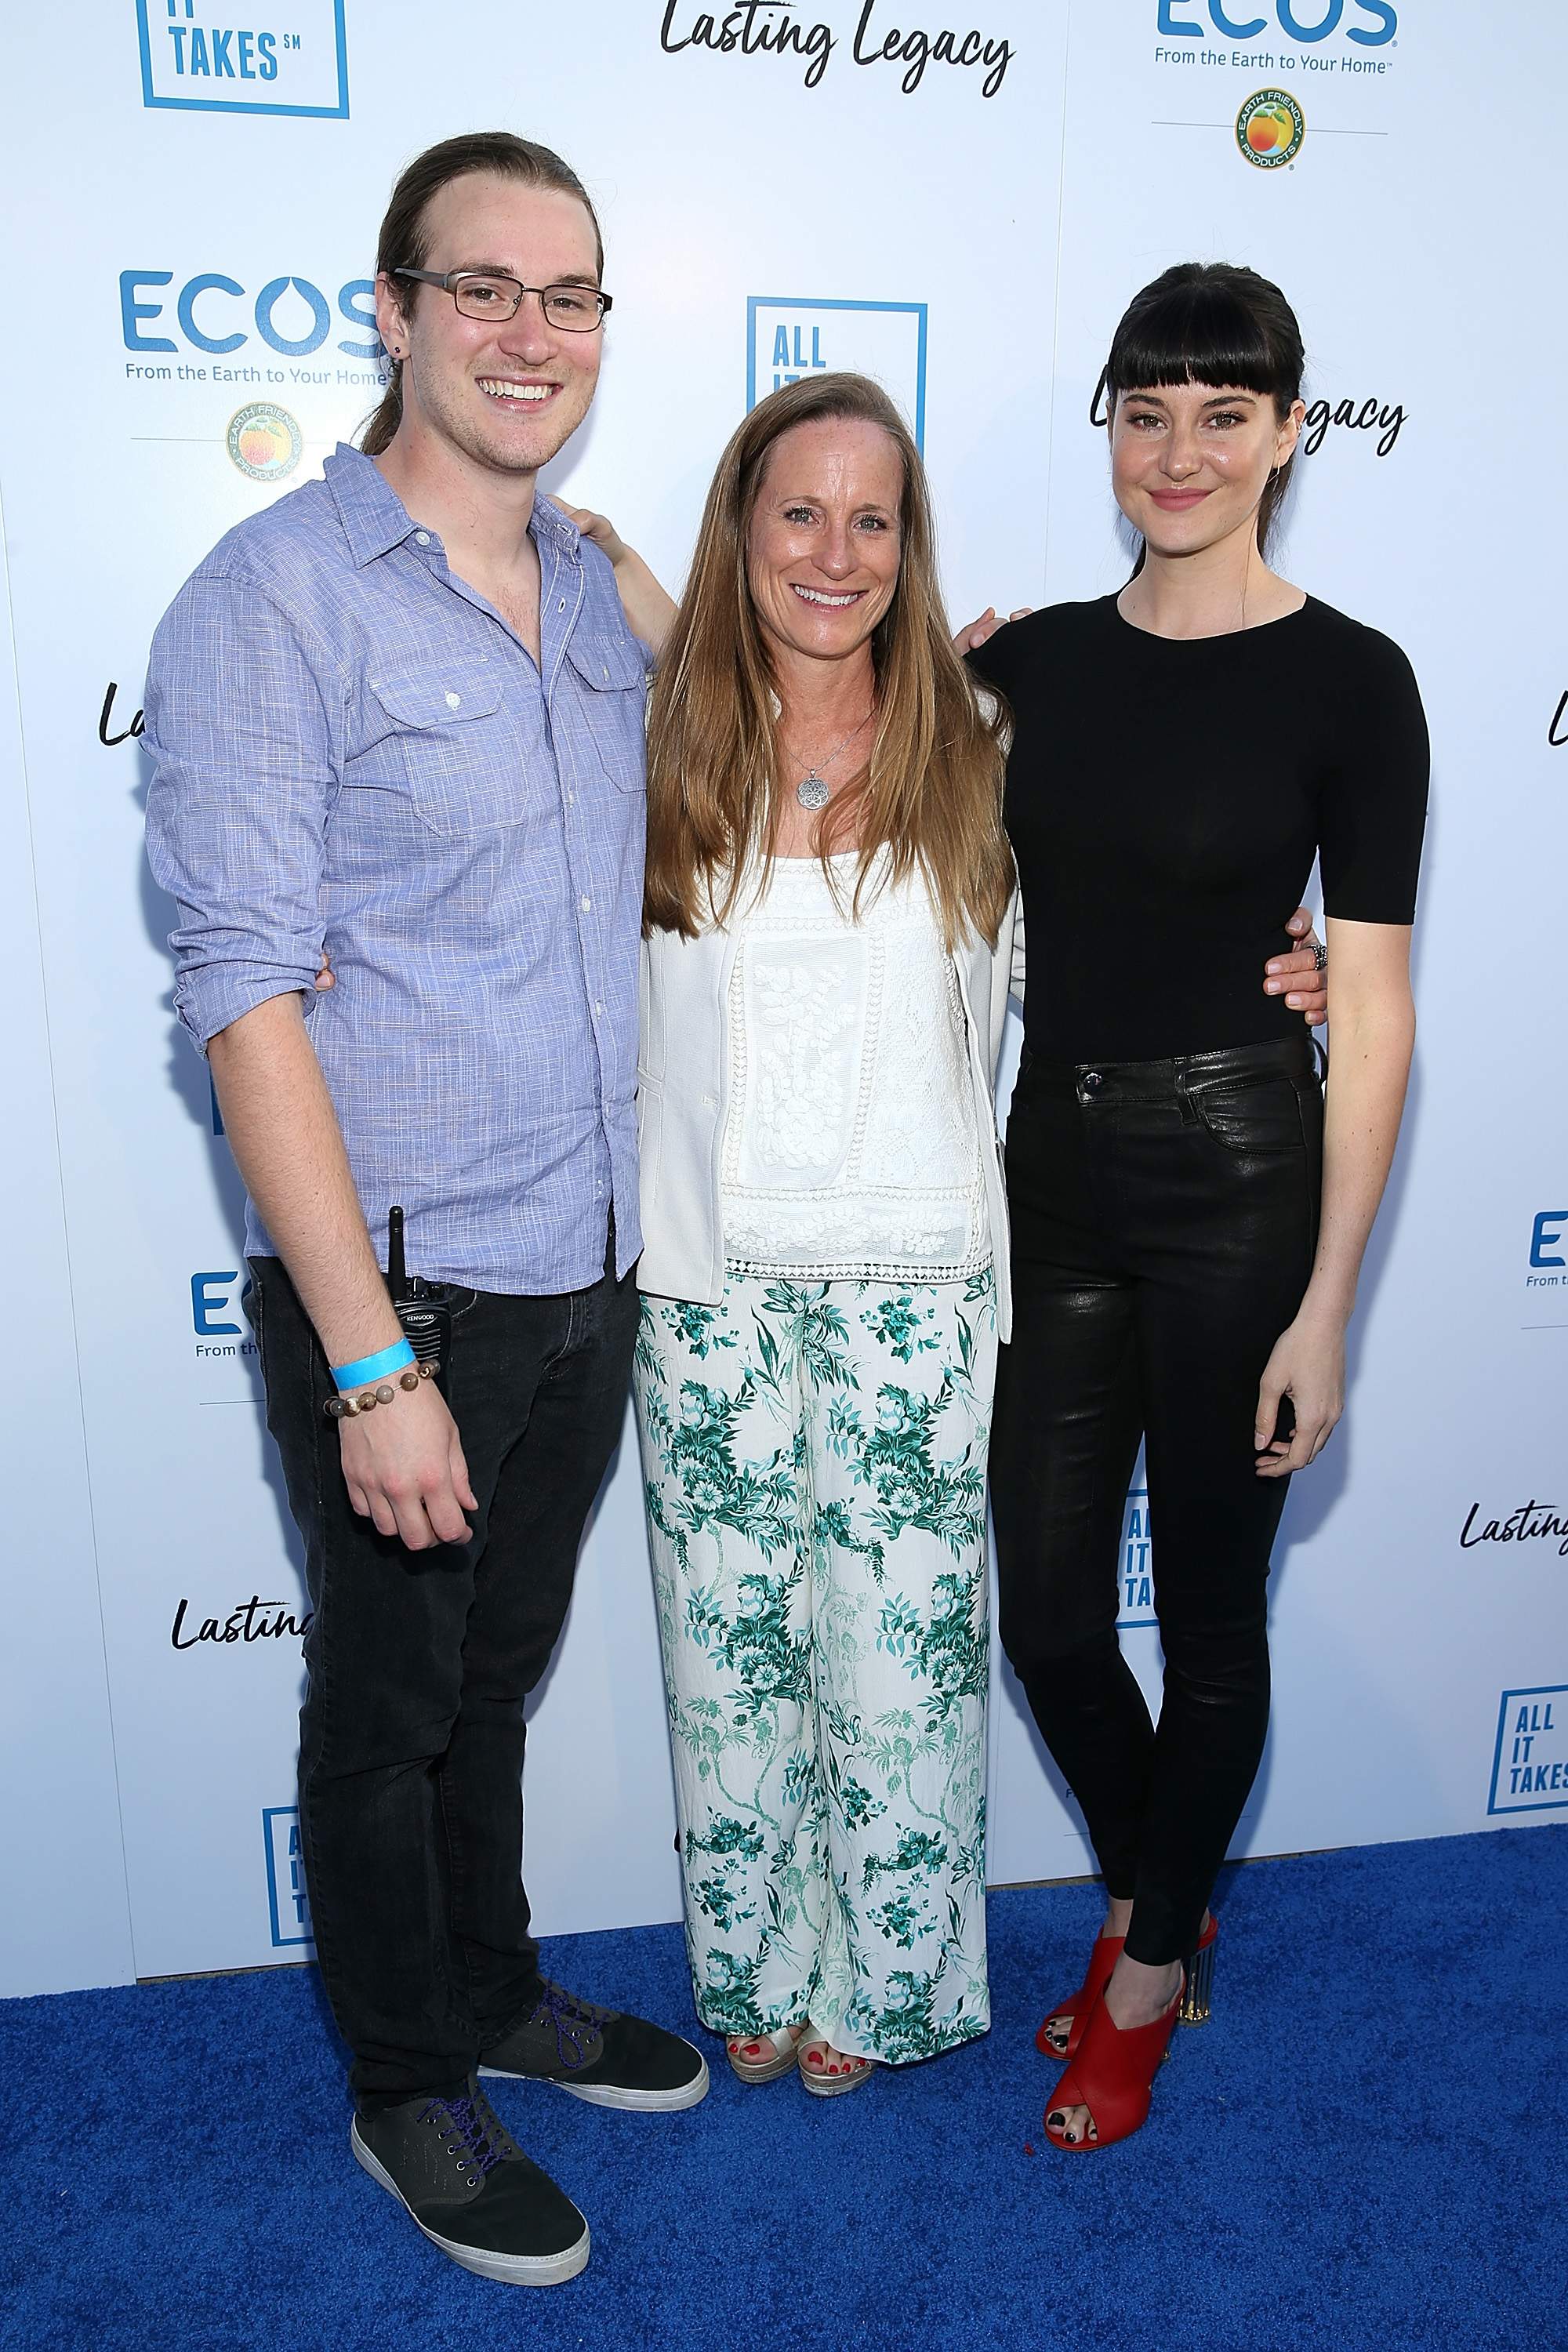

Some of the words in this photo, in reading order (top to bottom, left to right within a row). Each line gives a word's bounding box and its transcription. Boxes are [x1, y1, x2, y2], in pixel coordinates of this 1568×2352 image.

[168, 26, 278, 81] TAKES
[661, 0, 839, 88] Lasting
[853, 0, 1017, 98] Legacy
[1155, 47, 1196, 64] From
[1200, 49, 1226, 66] the
[1232, 51, 1274, 68] Earth
[1279, 54, 1294, 69] to
[1300, 55, 1337, 71] Your
[1239, 93, 1265, 131] EARTH
[1267, 92, 1303, 135] FRIENDLY
[1241, 143, 1296, 167] PRODUCTS
[119, 270, 389, 359] ECOS
[772, 325, 826, 368] ALL
[125, 363, 172, 379] From
[177, 365, 207, 380] the
[212, 366, 260, 382] Earth
[267, 368, 285, 383] to
[289, 368, 332, 383] Your
[229, 408, 256, 445] EARTH
[258, 405, 301, 449] FRIENDLY
[1303, 397, 1410, 457] gacy
[236, 457, 296, 481] PRODUCTS
[1526, 1276, 1558, 1287] From
[196, 1345, 236, 1357] From
[241, 1342, 258, 1356] th
[1127, 1543, 1149, 1573] IT
[172, 1595, 314, 1658] Lastin
[1515, 1704, 1554, 1733] ALL
[1512, 1736, 1534, 1764] IT
